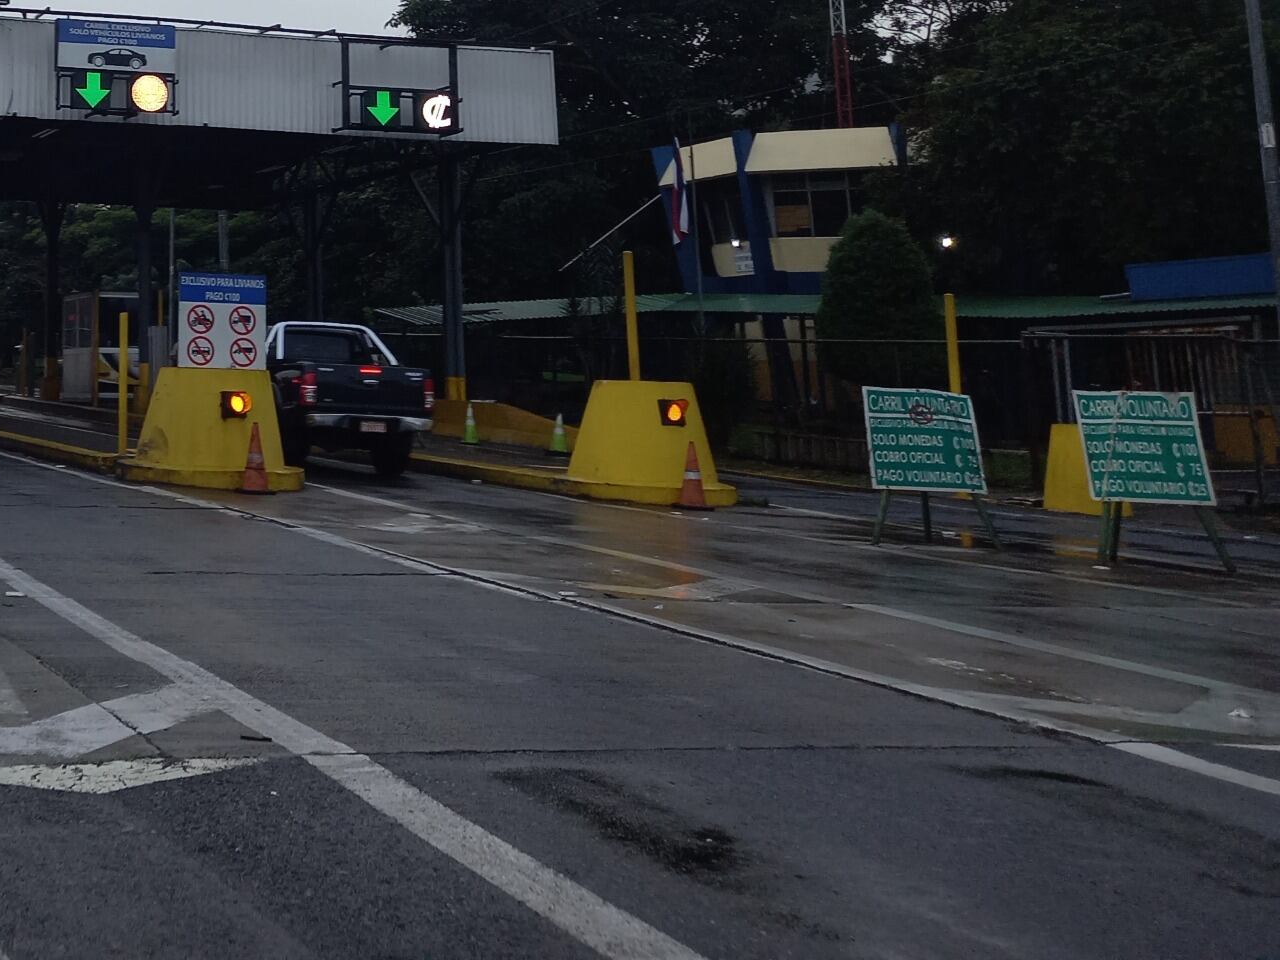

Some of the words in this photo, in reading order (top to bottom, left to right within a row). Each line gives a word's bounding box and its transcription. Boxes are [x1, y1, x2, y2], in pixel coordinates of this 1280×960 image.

[181, 276, 216, 287] EXCLUSIVO
[216, 277, 234, 288] PARA
[234, 278, 265, 289] LIVIANOS
[205, 291, 224, 301] PAGO
[869, 395, 905, 411] CARRIL
[906, 396, 968, 416] VOLUNTARIO
[1120, 400, 1189, 418] VOLUNTARIO
[872, 434, 897, 446] SOLO
[898, 434, 944, 447] MONEDAS
[1087, 441, 1113, 454] SOLO
[1115, 441, 1162, 454] MONEDAS
[874, 451, 908, 463] COBRO
[909, 452, 946, 465] OFICIAL
[1128, 461, 1167, 474] OFICIAL
[1189, 463, 1203, 477] 75
[876, 469, 904, 481] PAGO
[905, 470, 962, 484] VOLUNTARIO
[1094, 479, 1125, 492] PAGO
[1126, 480, 1186, 495] VOLUNTARIO
